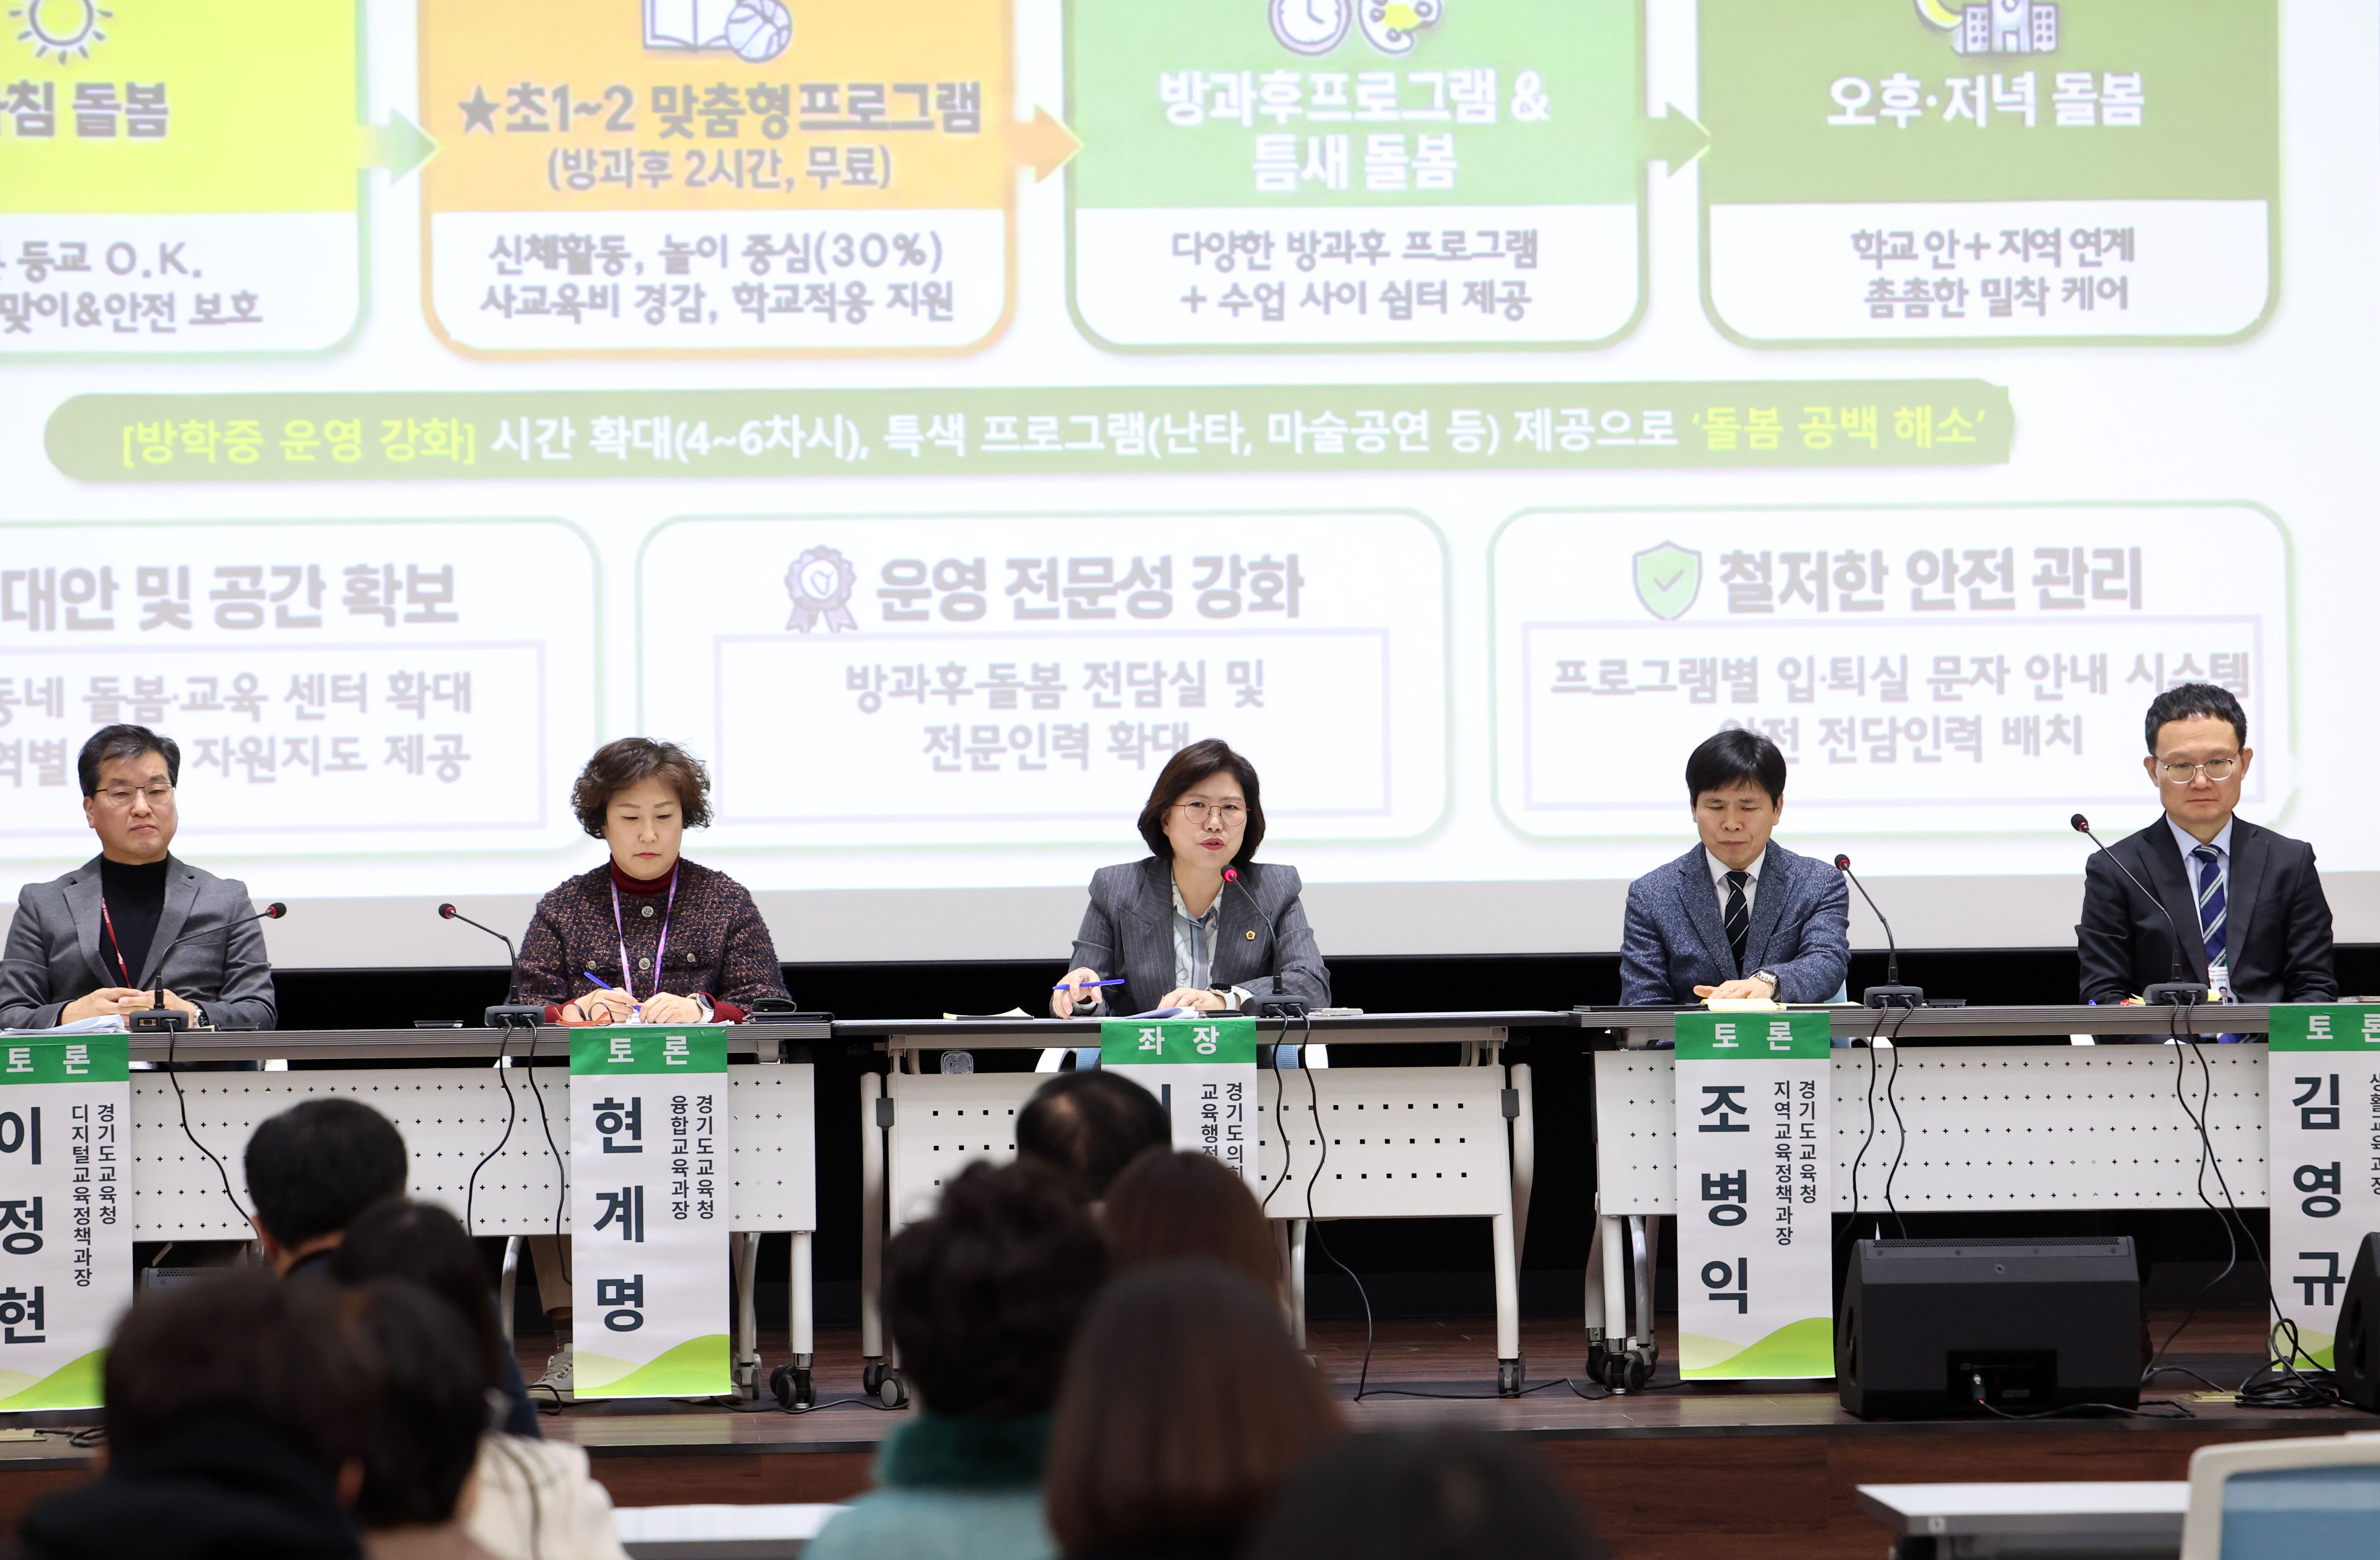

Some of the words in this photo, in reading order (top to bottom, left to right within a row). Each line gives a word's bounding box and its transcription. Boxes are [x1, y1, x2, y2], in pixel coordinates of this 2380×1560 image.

[0, 80, 54, 137] 침
[72, 82, 168, 137] 돌봄
[651, 81, 981, 140] 맞춤형프로그램
[1158, 68, 1498, 126] 방과후프로그램
[1510, 70, 1551, 122] &
[1826, 72, 2038, 128] 오후·저녁
[2052, 72, 2145, 126] 돌봄
[548, 147, 673, 192] (방과후
[685, 149, 795, 192] 2시간,
[805, 147, 891, 189] 무료)
[1253, 134, 1350, 191] 틈새
[1364, 133, 1457, 190] 돌봄
[16, 240, 91, 283] 등교
[105, 241, 202, 279] O.K.
[488, 234, 644, 276] 신체활동,
[657, 234, 729, 274] 놀이
[741, 231, 944, 275] 중심(30%)
[1172, 230, 1275, 273] 다양한
[1287, 230, 1391, 273] 방과후
[1401, 229, 1538, 269] 프로그램
[1851, 229, 1918, 270] 학교
[1999, 228, 2062, 268] 지역
[2069, 227, 2134, 266] 연계
[189, 290, 263, 325] 보호
[480, 282, 621, 325] 사교육비
[634, 283, 717, 325] 경감,
[731, 282, 874, 324] 학교적응
[886, 281, 954, 323] 지원
[1181, 286, 1207, 315] +
[1217, 281, 1285, 321] 수업
[1300, 281, 1367, 316] 사이
[1380, 280, 1448, 321] 쉼터
[1462, 279, 1532, 321] 제공
[1864, 278, 1969, 319] 촘촘한
[1981, 277, 2050, 318] 밀착
[2061, 276, 2128, 311] 케어
[123, 419, 264, 467] [방학중
[279, 418, 363, 462] 운영
[379, 417, 475, 465] 강화]
[492, 415, 576, 462] 시간
[883, 412, 966, 457] 특색
[981, 410, 1253, 458] 프로그램(난타,
[1268, 408, 1430, 453] 마술공연
[1445, 410, 1501, 456] 등)
[1513, 408, 1678, 452] 제공으로
[1798, 405, 1878, 450] 공백
[1, 566, 120, 632] 대안
[135, 565, 194, 631] 및
[209, 564, 327, 630] 공간
[342, 563, 459, 627] 확보
[876, 557, 988, 622] 운영
[1005, 554, 1174, 621] 전문성
[1192, 554, 1305, 619] 강화
[1719, 548, 1888, 614] 철저한
[1906, 548, 2016, 612] 안전
[2032, 547, 2141, 611] 관리
[284, 672, 367, 721] 센터
[386, 670, 472, 719] 확대
[1082, 659, 1207, 709] 전담실
[1226, 659, 1265, 709] 및
[1550, 656, 1760, 705] 프로그램별
[1927, 653, 2010, 702] 문자
[2024, 652, 2109, 701] 안내
[192, 734, 367, 785] 자원지도
[384, 733, 471, 783] 제공
[922, 722, 1089, 771] 전문인력
[1817, 715, 1984, 765] 전담인력
[2002, 712, 2083, 759] 배치
[98, 1104, 117, 1224] 경기도교육청
[671, 1095, 690, 1220] 융합교육과장
[696, 1095, 714, 1220] 경기도교육청
[1774, 1080, 1793, 1246] 지역교육정책과장
[1799, 1080, 1817, 1203] 경기도교육청
[72, 1104, 92, 1287] 디지털교육정책과장
[593, 1097, 644, 1332] 현계명
[1699, 1086, 1750, 1314] 조병익
[2292, 1074, 2346, 1306] 김영규
[0, 1107, 45, 1344] 이정현
